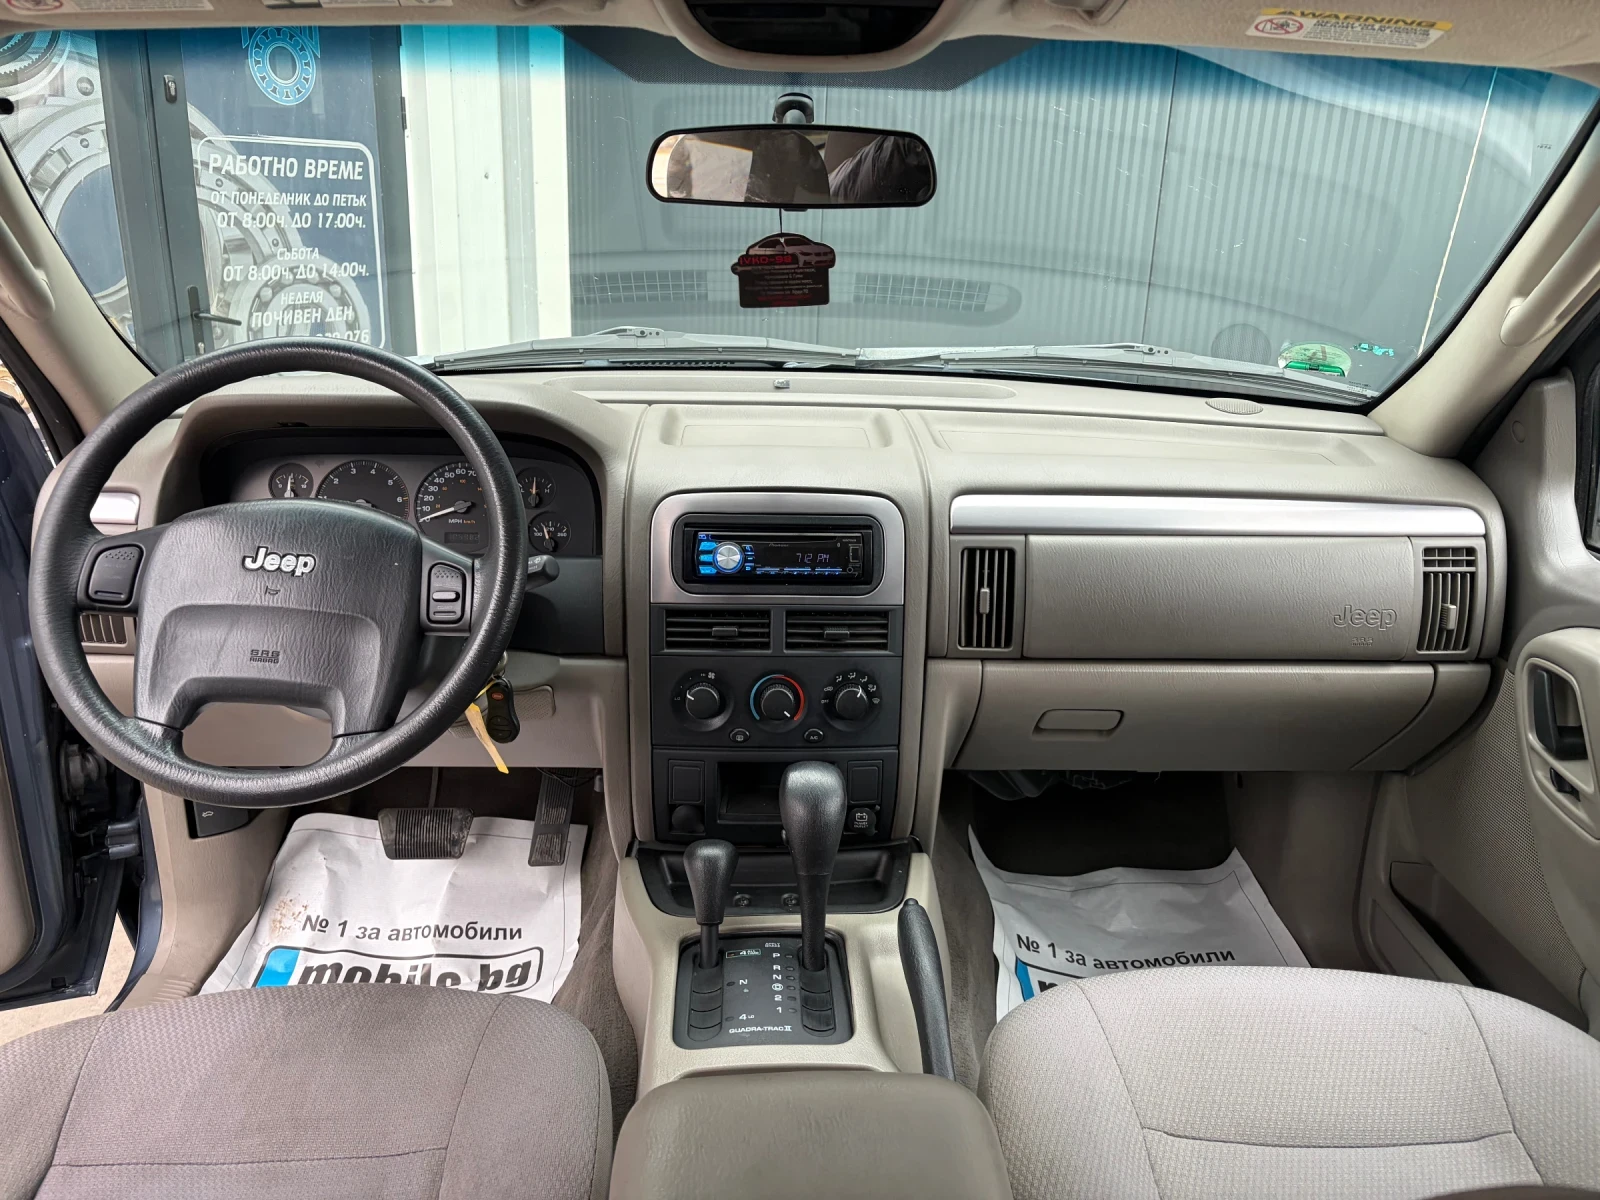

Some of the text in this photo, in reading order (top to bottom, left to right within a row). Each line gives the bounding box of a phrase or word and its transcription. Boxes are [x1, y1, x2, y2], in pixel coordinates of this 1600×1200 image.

[1300, 10, 1437, 28] WARNING
[208, 153, 364, 180] РАБОТНО ВРЕМЕ
[211, 191, 367, 207] ОТ ПОНЕДЕЛНИК ДО ПЕТЪК
[217, 212, 240, 228] ОТ
[290, 212, 312, 228] ДО
[276, 247, 320, 261] СЪБОТА
[223, 266, 244, 282] ОТ
[296, 263, 316, 280] ДО
[280, 291, 324, 305] НЕДЕЛЯ
[251, 306, 353, 328] ПОЧИВЕН ДЕН
[242, 546, 316, 577] Jeep
[1333, 604, 1398, 631] Jeep
[337, 919, 348, 938] 1
[355, 925, 382, 941] за
[387, 920, 523, 942] автомобили
[1047, 943, 1057, 958] 1
[1065, 950, 1088, 967] за
[1093, 950, 1236, 970] автомобили
[729, 1026, 784, 1034] QUADRA-TRAC
